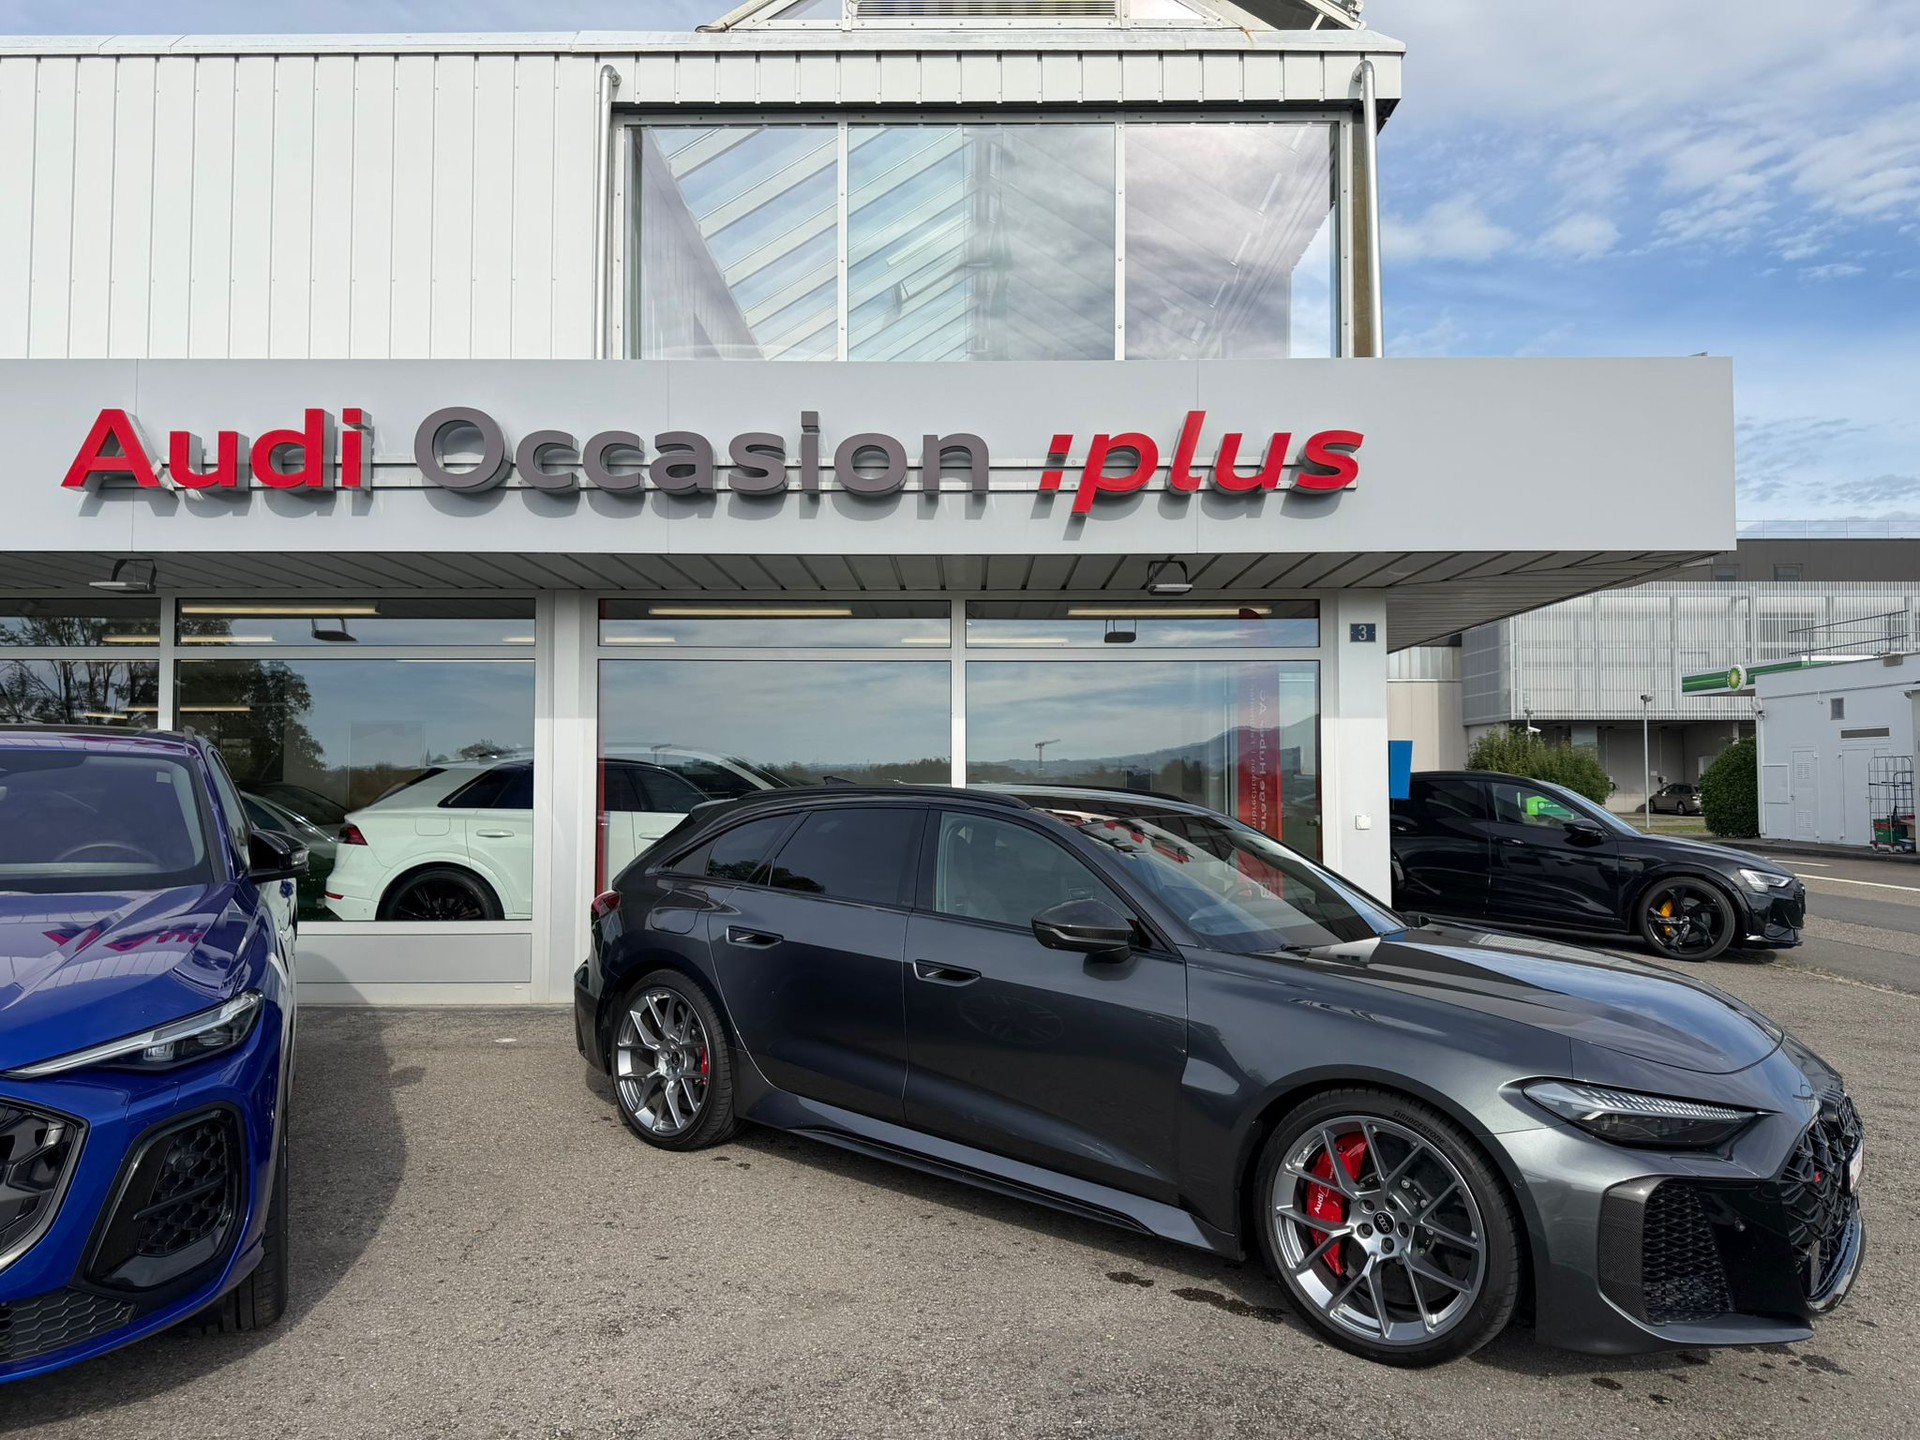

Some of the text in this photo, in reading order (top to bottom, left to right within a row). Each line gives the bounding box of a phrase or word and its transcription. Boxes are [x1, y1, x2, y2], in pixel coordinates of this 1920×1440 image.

[61, 408, 361, 488] Audi
[414, 407, 989, 491] Occasion
[1358, 625, 1367, 640] 3
[1314, 1192, 1325, 1215] Audi
